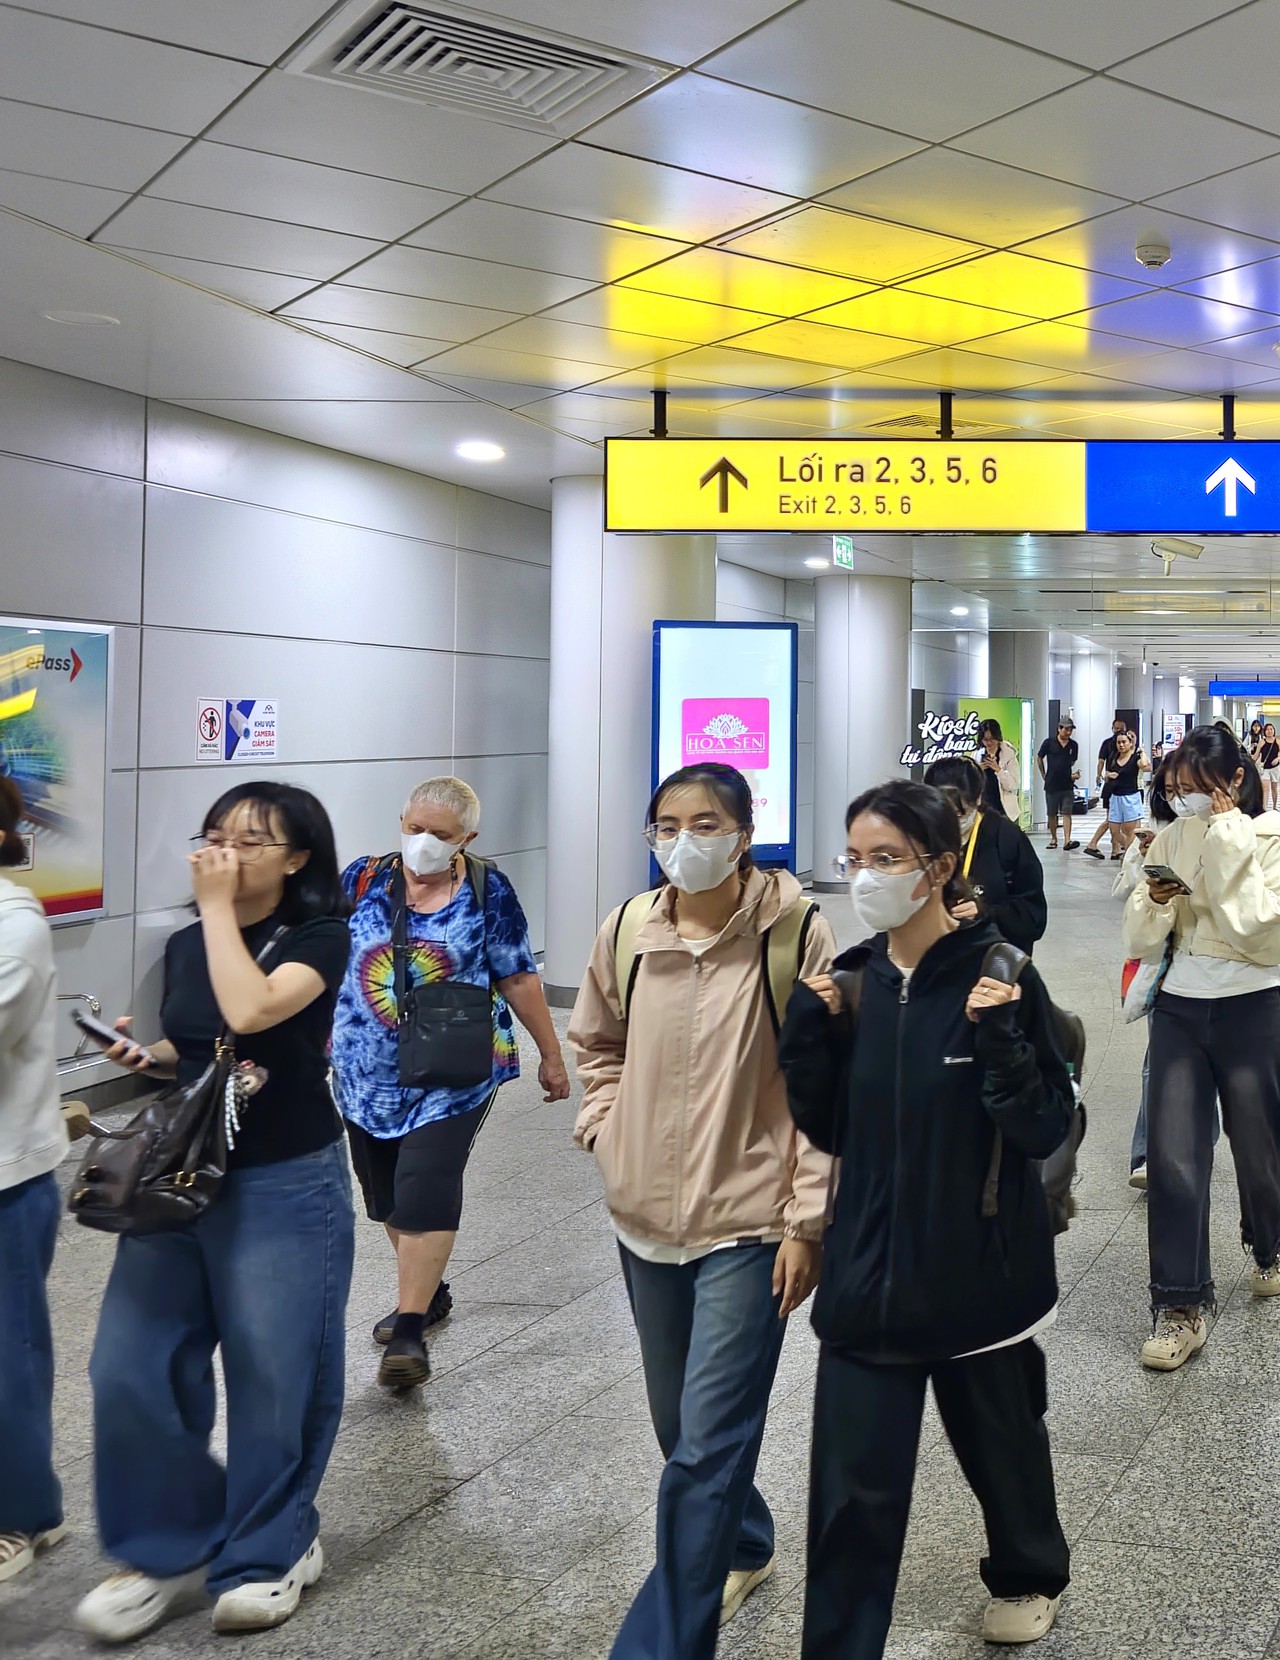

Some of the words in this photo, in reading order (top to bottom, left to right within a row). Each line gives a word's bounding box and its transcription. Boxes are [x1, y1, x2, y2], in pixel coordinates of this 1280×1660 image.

[779, 453, 823, 482] Lối
[835, 464, 864, 482] ra
[875, 457, 899, 485] 2,
[911, 457, 934, 485] 3,
[946, 457, 970, 485] 5,
[982, 458, 997, 484] 6
[779, 495, 817, 514] Exit
[825, 495, 842, 515] 2,
[850, 495, 867, 515] 3,
[875, 495, 892, 515] 5,
[900, 496, 911, 515] 6
[918, 711, 979, 741] Kiosk
[688, 737, 726, 750] HOA
[733, 737, 763, 749] SEN
[943, 733, 977, 751] bán
